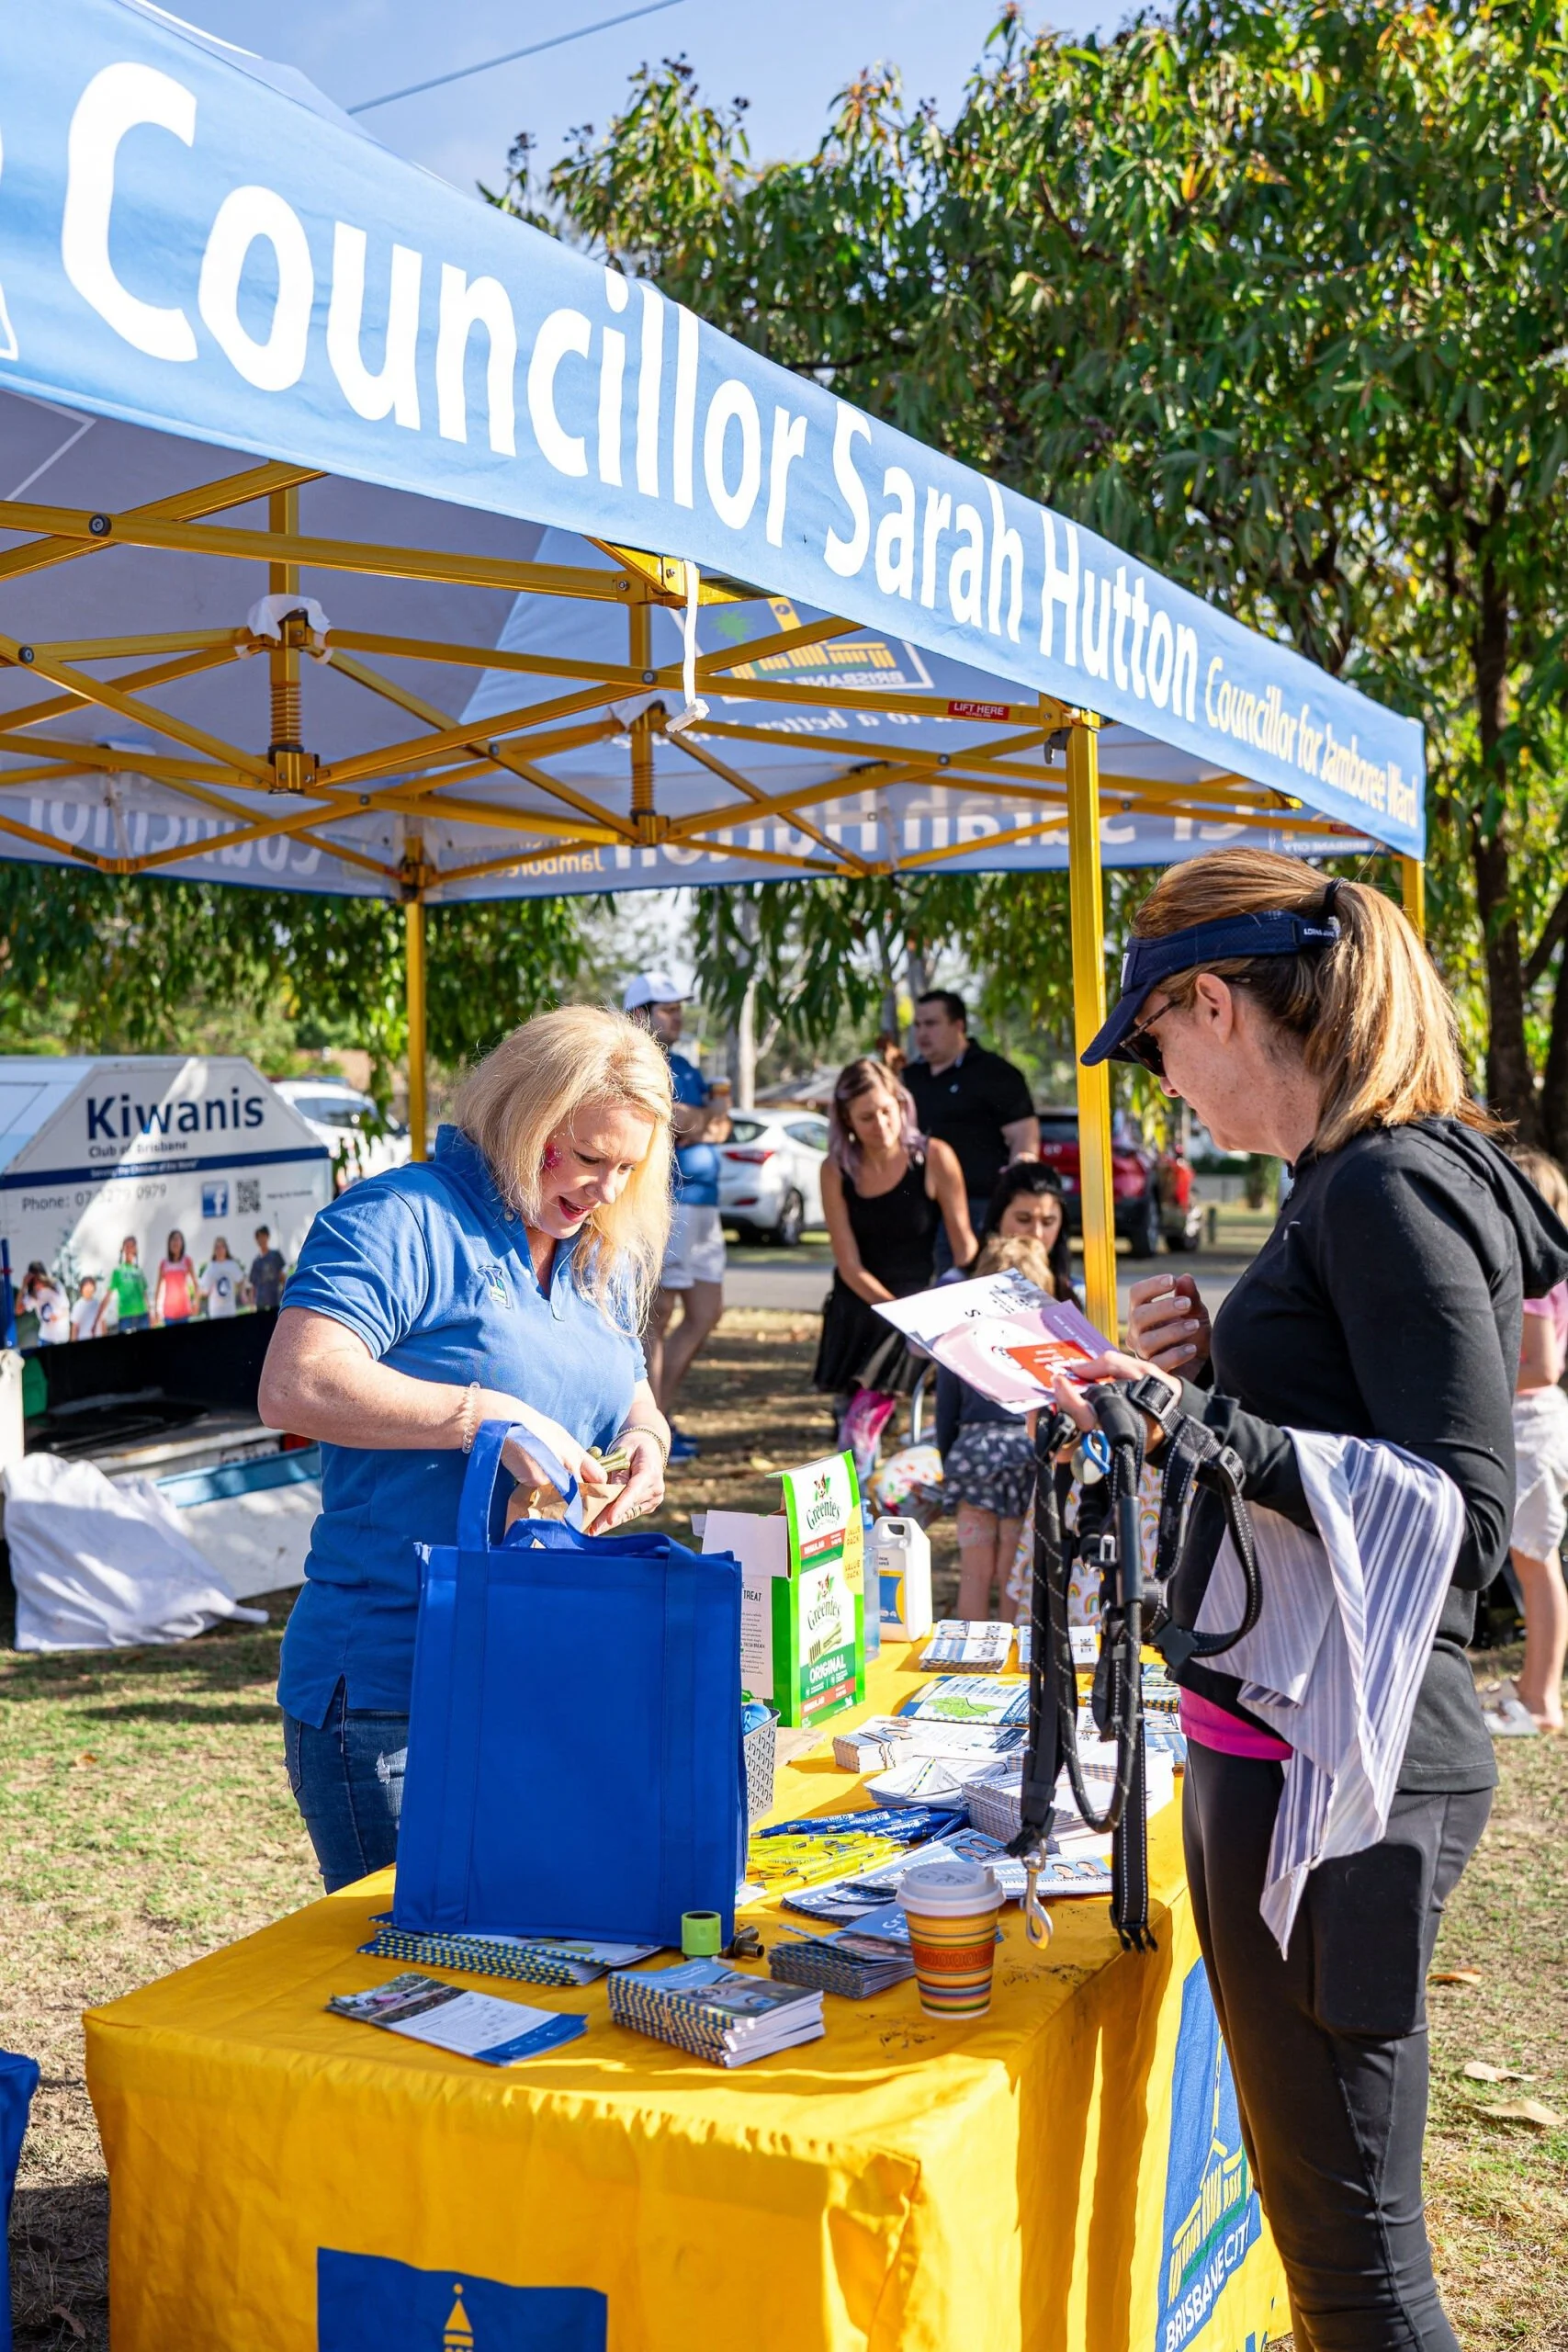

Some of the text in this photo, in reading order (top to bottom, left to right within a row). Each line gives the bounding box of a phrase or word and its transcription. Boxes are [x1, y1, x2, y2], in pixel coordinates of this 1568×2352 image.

[61, 61, 1419, 829] Councillor Sarah Hutton Councillor for Jamboree Ward
[953, 702, 976, 713] LIFT
[976, 706, 1005, 716] HERE
[85, 1086, 265, 1142] Kiwanis
[88, 1146, 118, 1159] Club
[21, 1195, 71, 1214] Phone:
[74, 1190, 93, 1207] 07
[137, 1182, 167, 1200] 0979
[806, 1497, 841, 1530] Greenies
[743, 1589, 762, 1602] TREAT
[807, 1596, 841, 1631] Greenies
[809, 1654, 846, 1683] ORIGINAL
[1166, 2207, 1251, 2352] BRISBANE CITY
